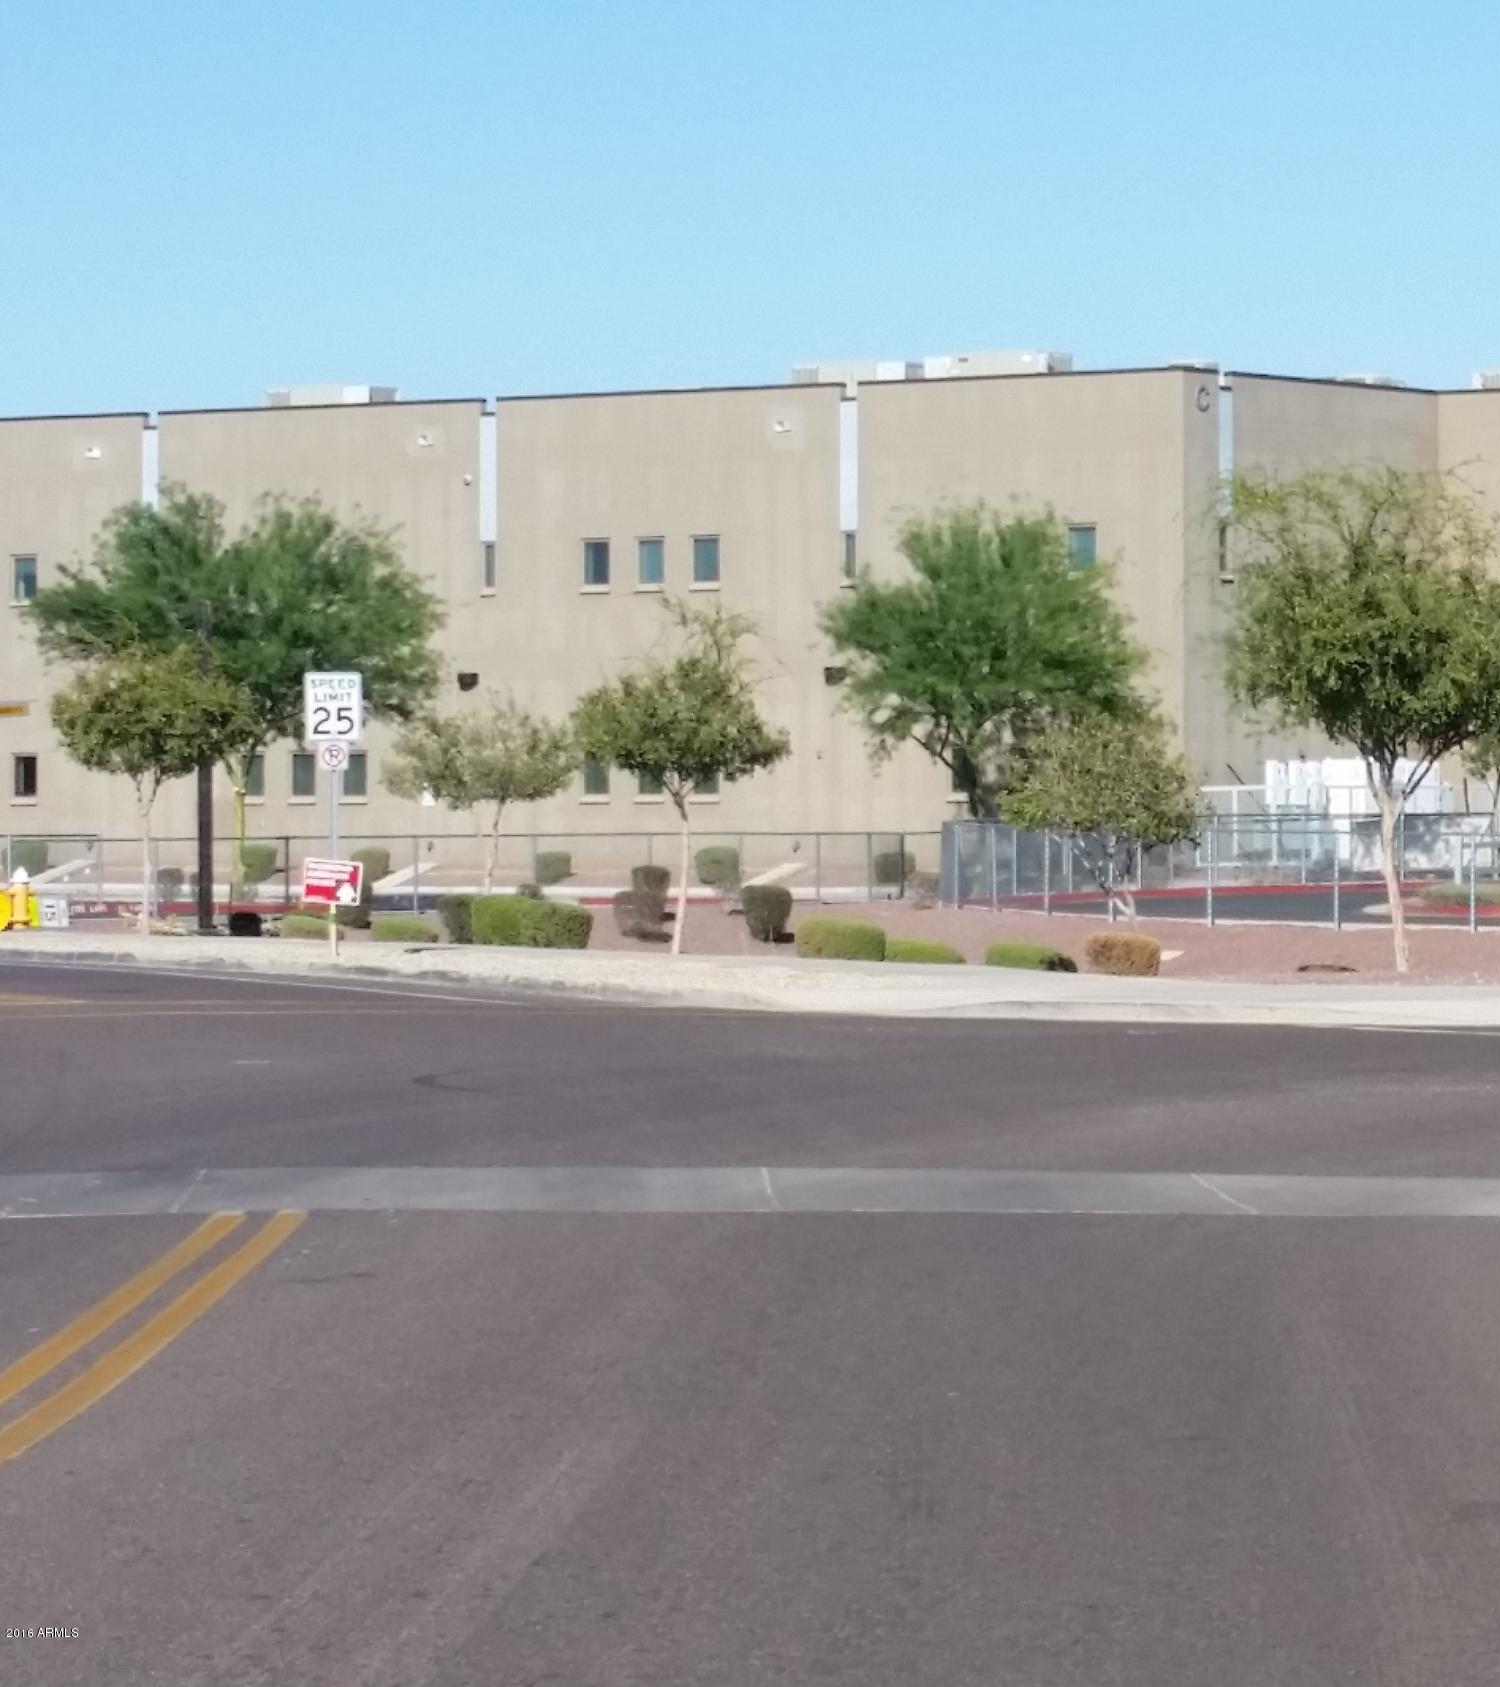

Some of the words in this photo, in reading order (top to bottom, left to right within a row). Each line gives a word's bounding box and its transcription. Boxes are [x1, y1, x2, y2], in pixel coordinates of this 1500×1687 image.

[311, 679, 357, 690] SPEED
[314, 692, 351, 703] LIMIT
[312, 706, 354, 735] 25
